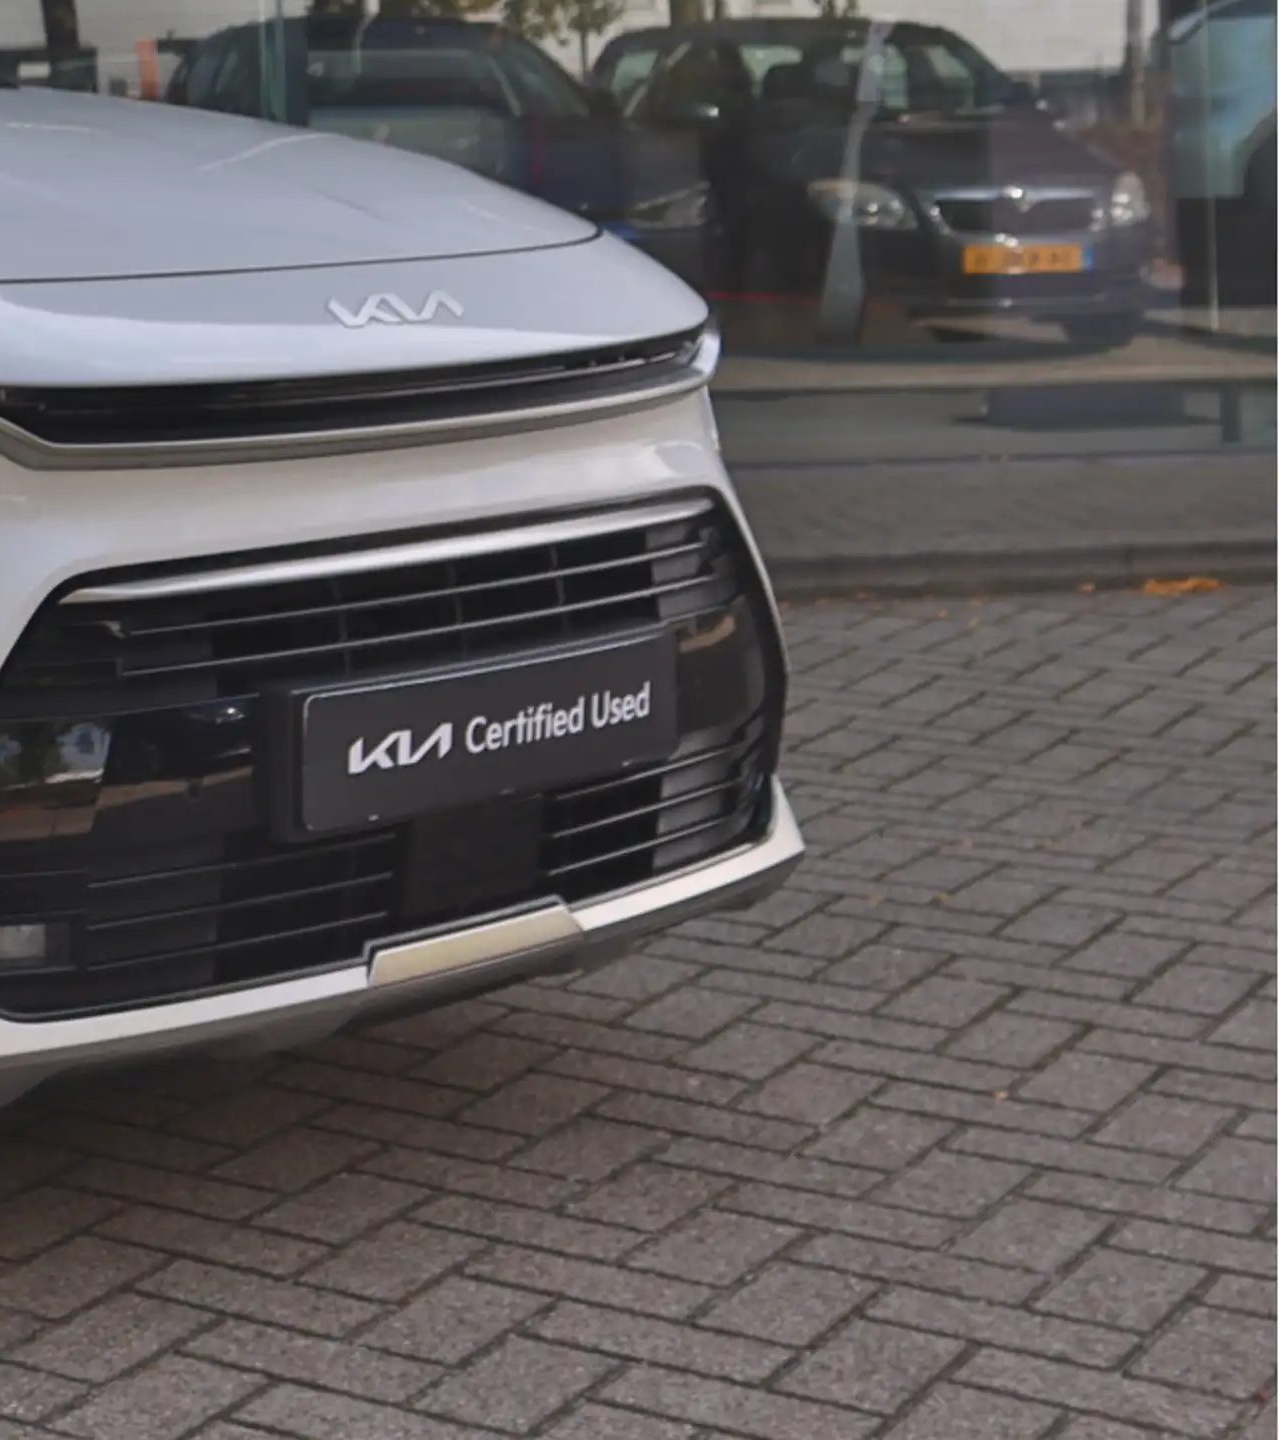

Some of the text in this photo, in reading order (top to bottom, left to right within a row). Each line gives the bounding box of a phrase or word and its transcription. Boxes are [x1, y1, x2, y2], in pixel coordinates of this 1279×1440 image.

[328, 290, 464, 328] KIA
[348, 681, 651, 775] KIA Certified Used
